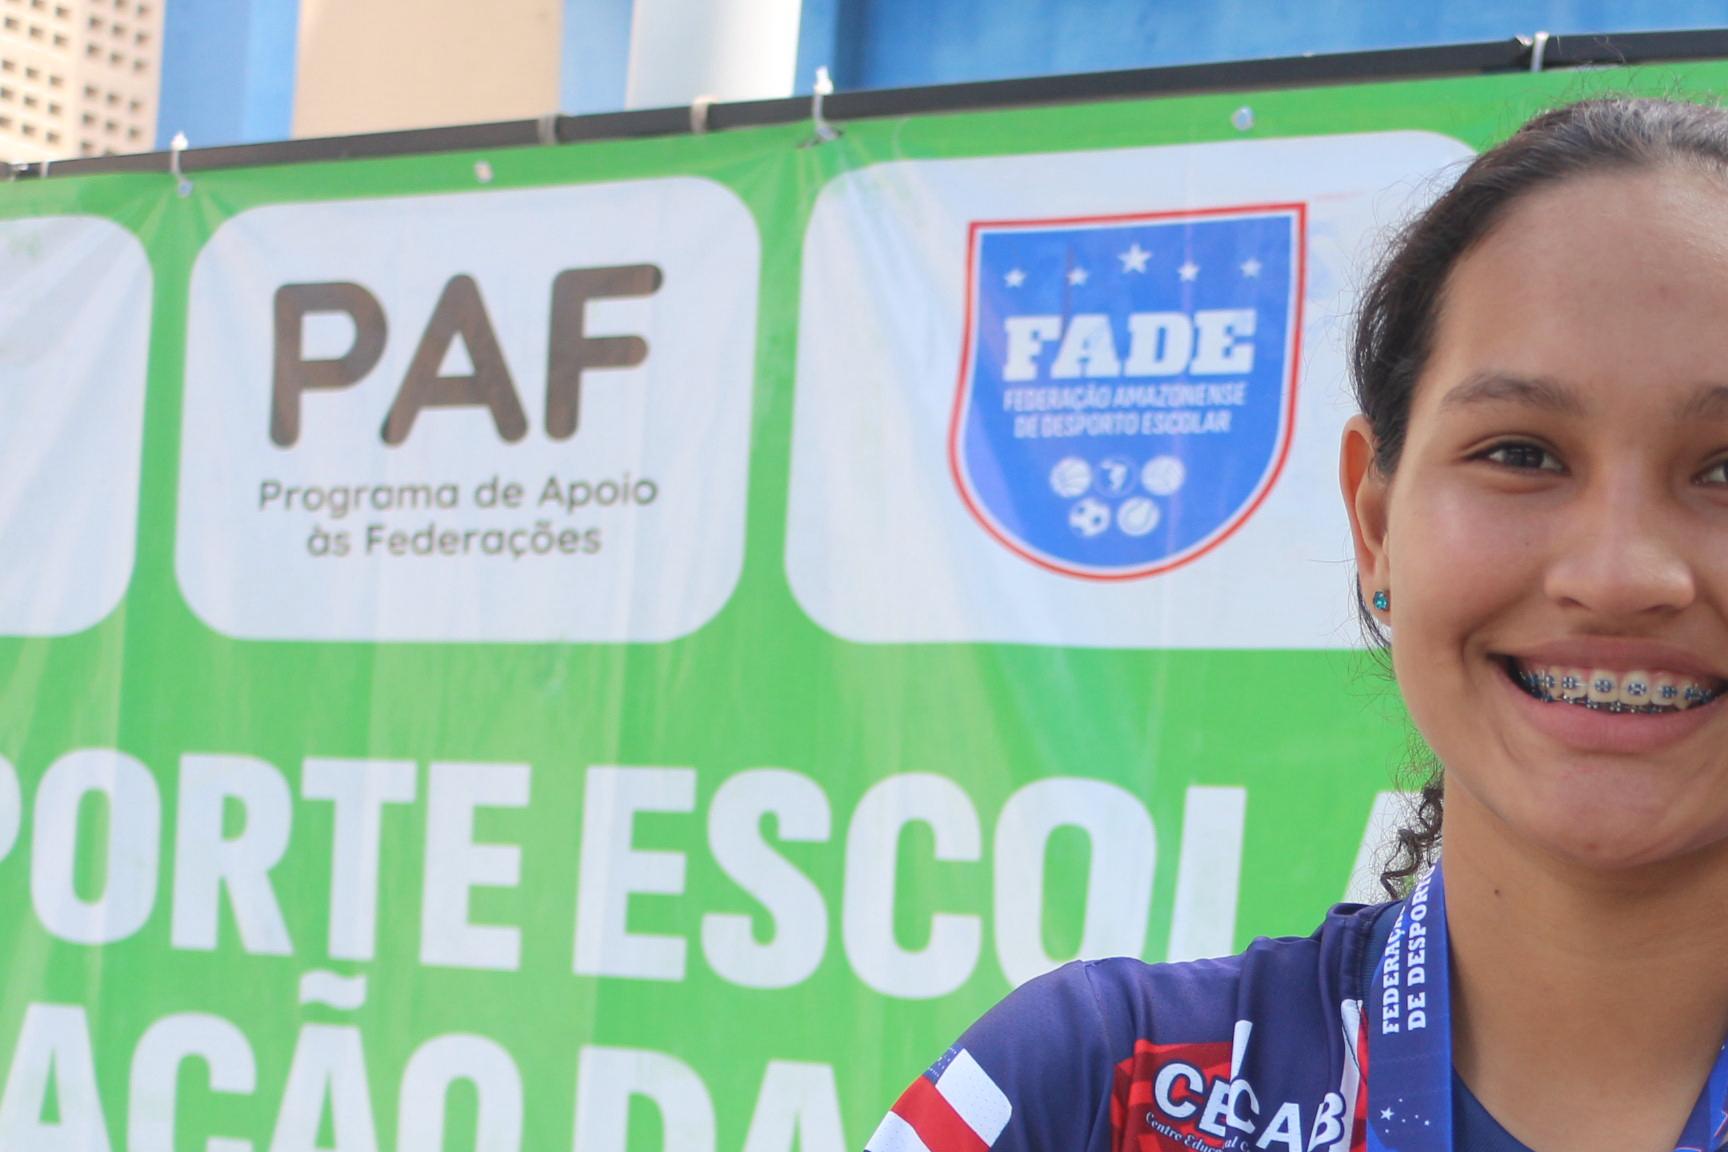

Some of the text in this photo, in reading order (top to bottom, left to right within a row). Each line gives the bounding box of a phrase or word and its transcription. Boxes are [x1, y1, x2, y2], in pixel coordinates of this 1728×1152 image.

[269, 264, 663, 448] PAF
[1003, 308, 1256, 381] FADE
[1112, 382, 1247, 408] AMAZONENSE
[1013, 409, 1232, 439] DE DESPORTO ESCOLAR
[259, 471, 659, 516] Programa de Apoio
[307, 519, 602, 563] às Federações
[0, 748, 530, 972] ORTE
[1407, 992, 1427, 1030] DE
